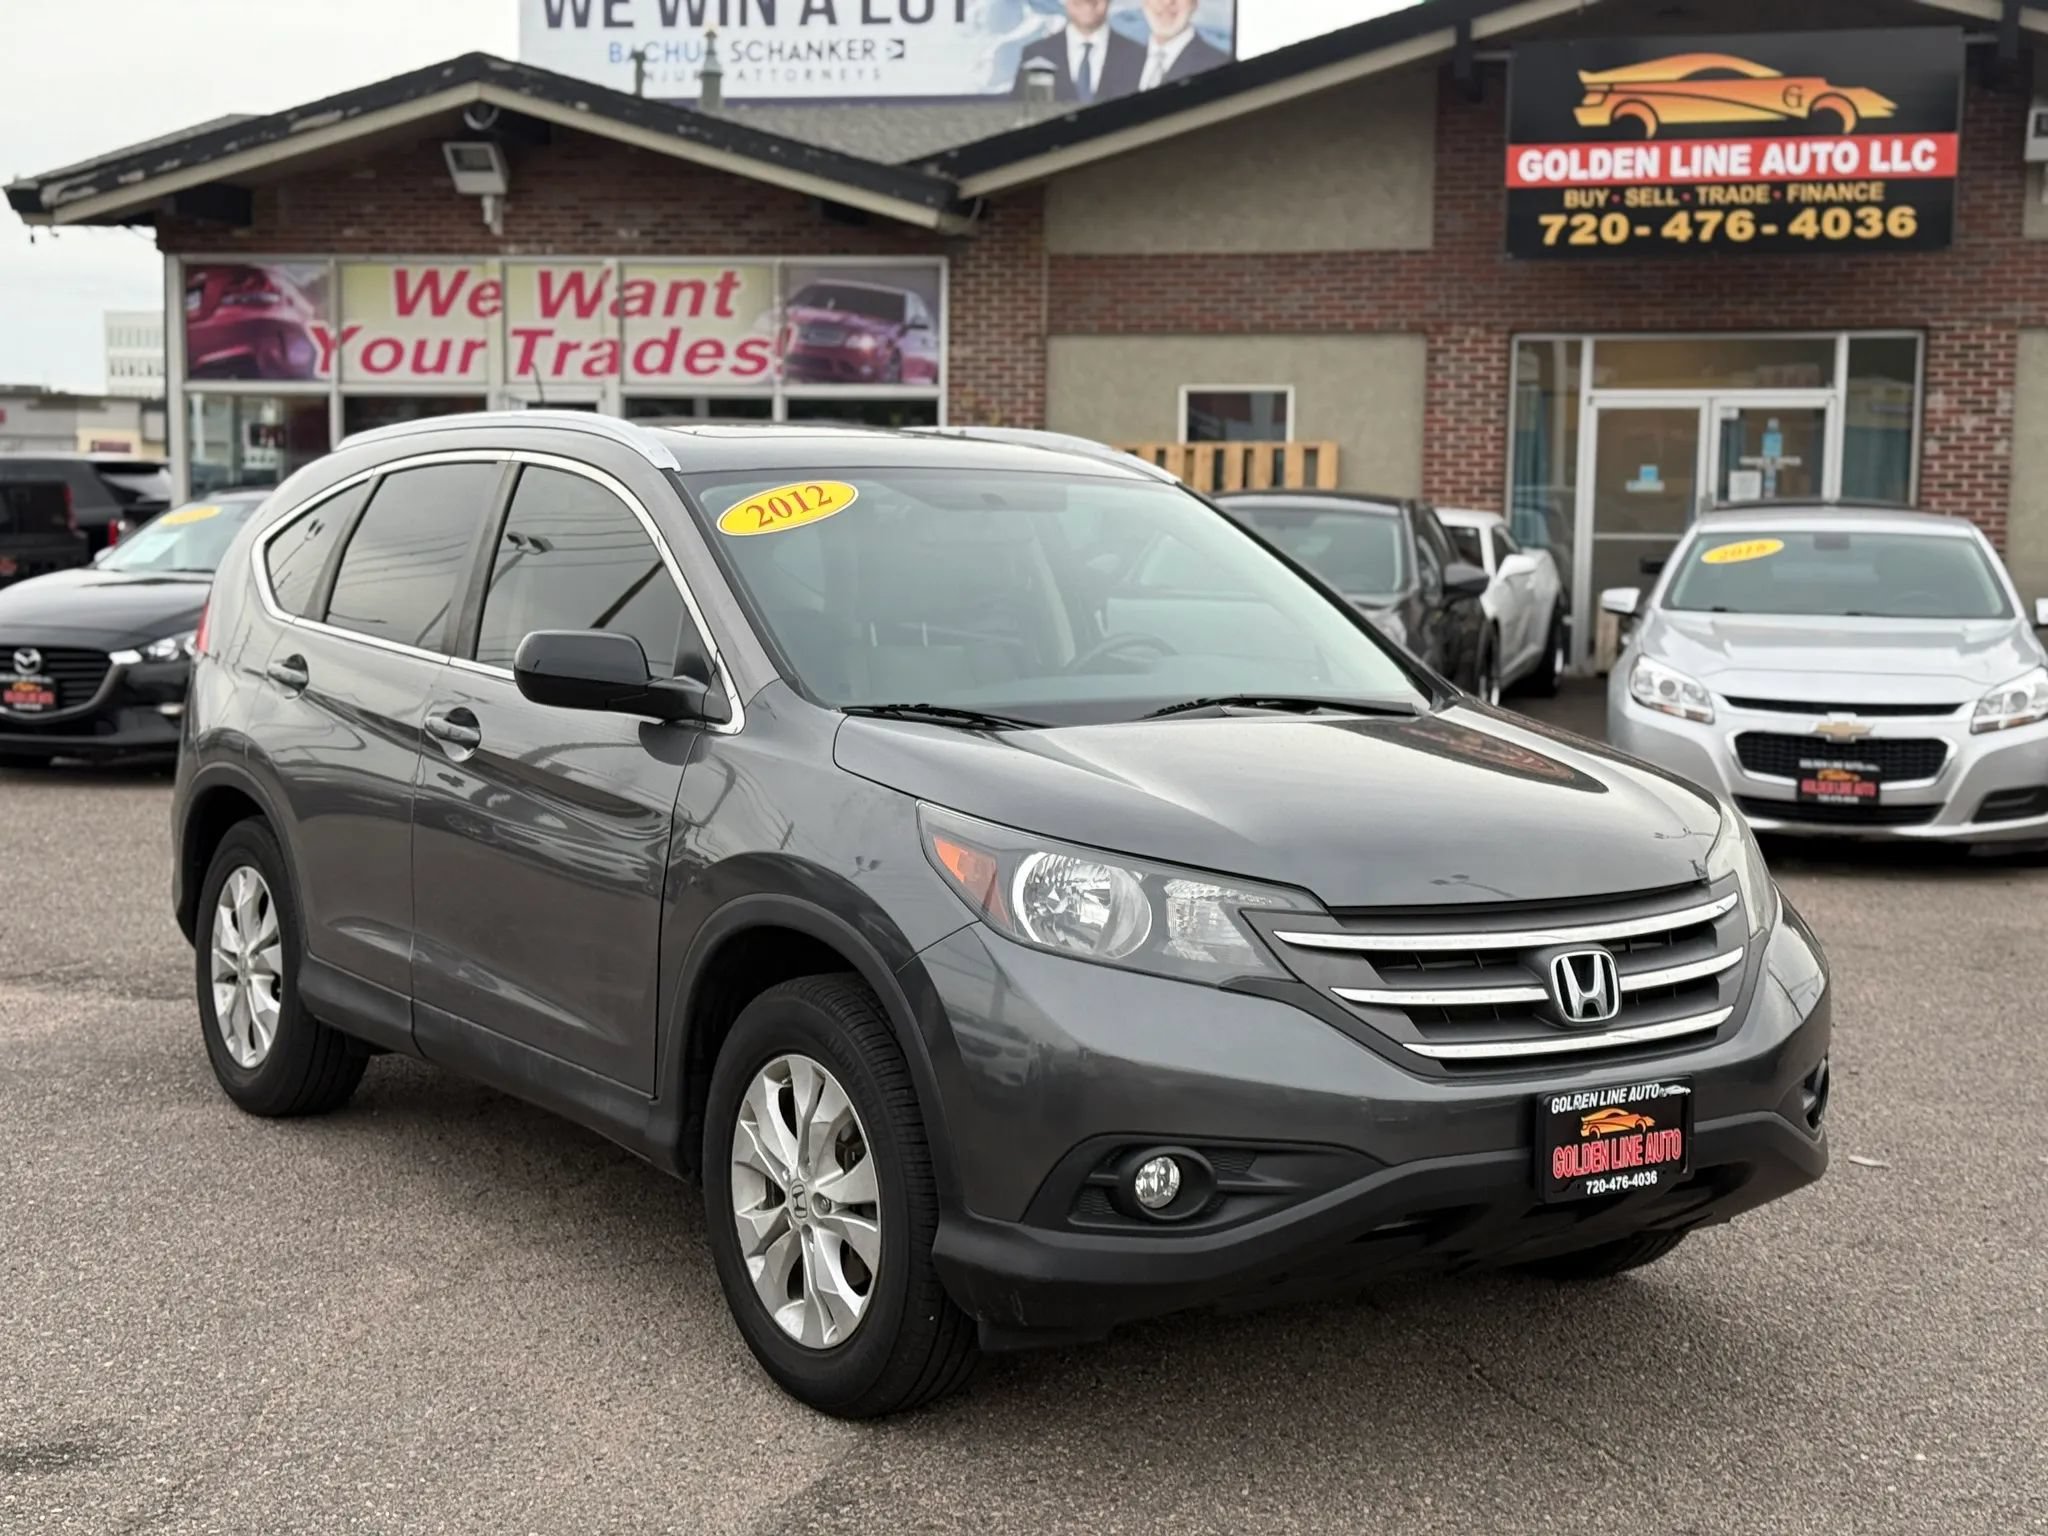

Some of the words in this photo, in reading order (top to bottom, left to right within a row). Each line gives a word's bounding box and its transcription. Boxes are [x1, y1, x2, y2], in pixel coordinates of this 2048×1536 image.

[543, 0, 634, 28] WE
[730, 39, 876, 62] SCHANKER
[1518, 147, 1660, 182] GOLDEN
[1669, 144, 1752, 177] LINE
[1760, 141, 1860, 175] AUTO
[1869, 138, 1937, 173] LLC
[1563, 188, 1610, 208] BUY
[1624, 186, 1680, 207] SELL
[1696, 184, 1770, 205] TRADE
[1786, 181, 1885, 203] FINANCE
[394, 268, 503, 318] We
[538, 268, 741, 319] Want
[310, 325, 487, 374] Your
[746, 485, 832, 528] 2012
[1599, 1088, 1627, 1106] LINE
[1628, 1083, 1660, 1102] AUTO
[1553, 1138, 1610, 1179] GOLDEN
[1611, 1134, 1643, 1170] LINE
[1645, 1128, 1682, 1165] AUTO
[1586, 1171, 1658, 1194] 720-476-4036
